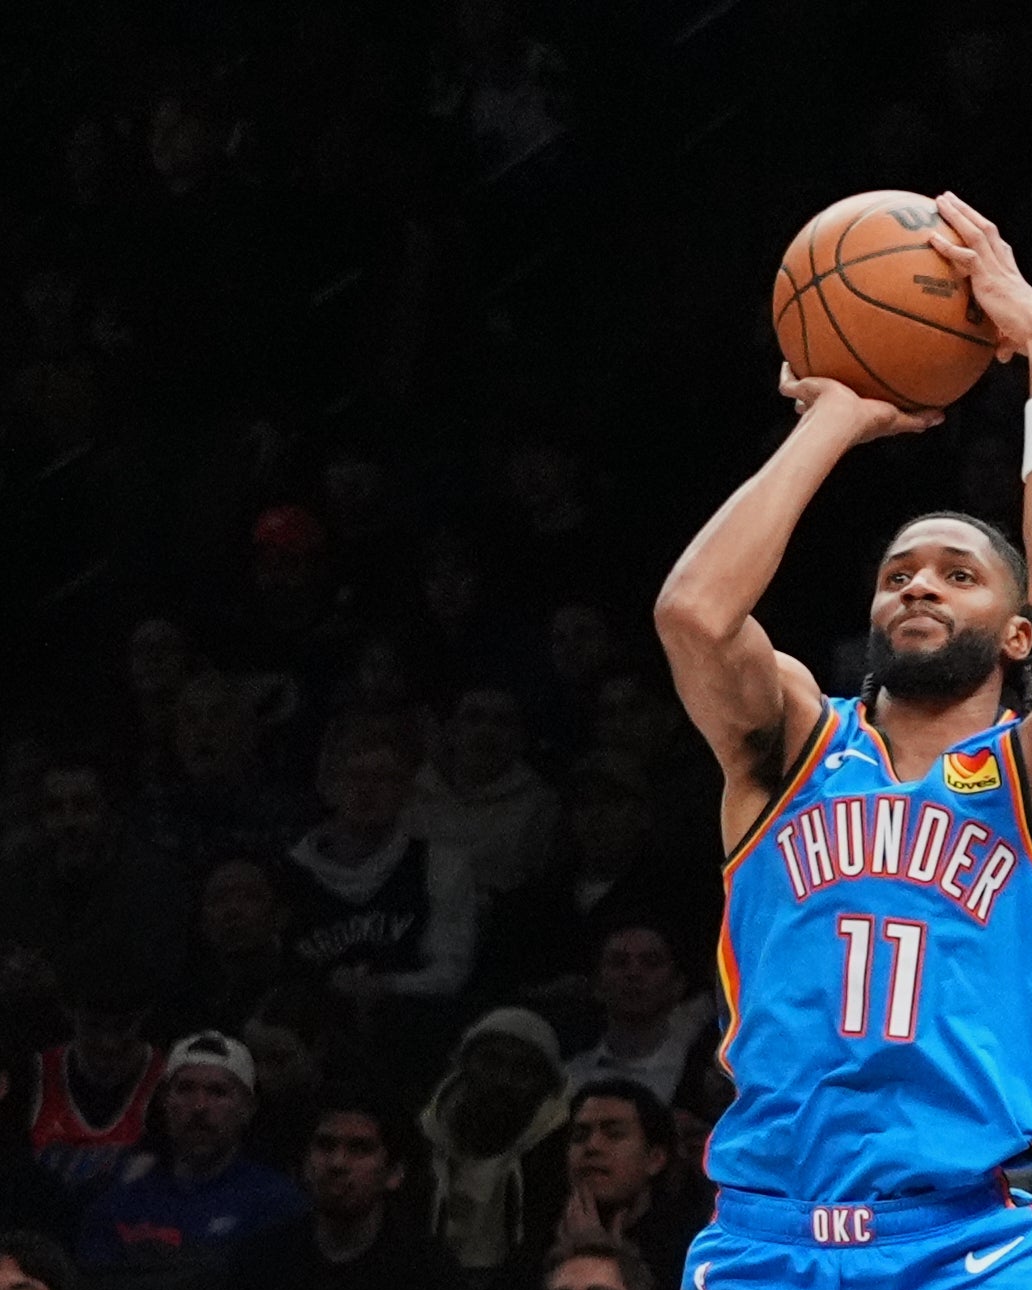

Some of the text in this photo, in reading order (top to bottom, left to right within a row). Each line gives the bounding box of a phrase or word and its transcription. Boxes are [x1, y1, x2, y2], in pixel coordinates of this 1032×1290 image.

[775, 795, 1018, 927] THUNDER
[837, 913, 928, 1042] 11
[811, 1205, 874, 1243] OKC
